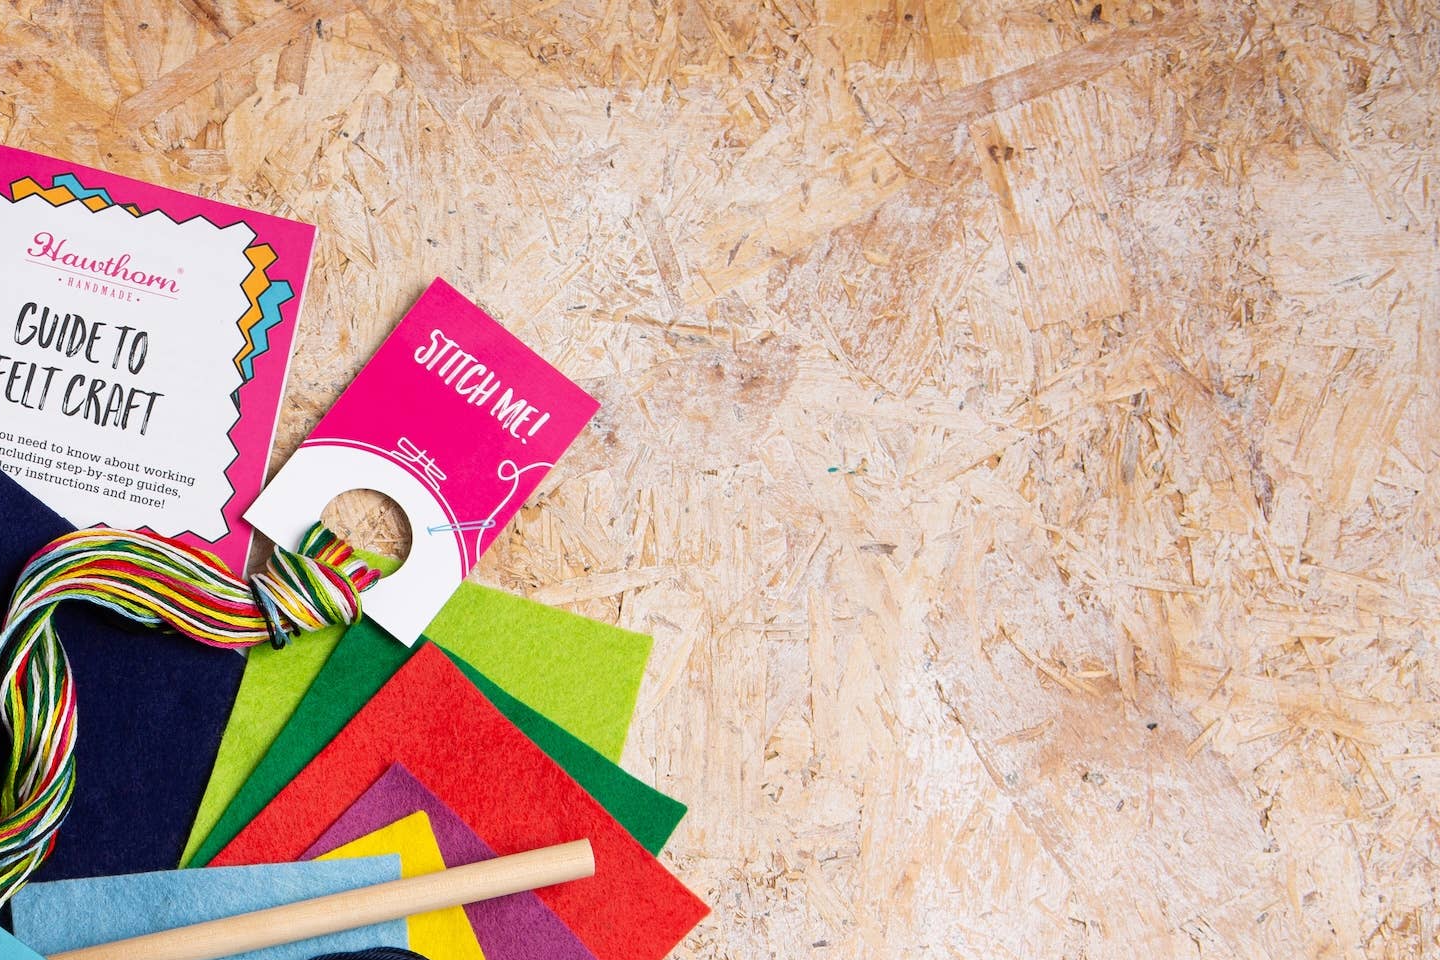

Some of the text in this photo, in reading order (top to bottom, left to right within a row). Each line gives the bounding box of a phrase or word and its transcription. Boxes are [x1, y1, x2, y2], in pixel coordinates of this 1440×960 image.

[27, 232, 180, 293] Hawthorn
[68, 277, 132, 302] HANDMADE
[14, 302, 148, 375] GUIDE TO
[62, 374, 165, 436] CRAFT
[414, 329, 551, 444] STITCH ME!
[17, 434, 48, 451] need
[51, 443, 63, 454] to
[67, 446, 101, 463] know
[104, 455, 140, 473] about
[144, 466, 195, 486] working
[25, 467, 99, 494] instructions
[103, 486, 126, 501] and
[129, 492, 165, 509] more!
[56, 460, 133, 488] step-by-step
[137, 476, 181, 498] guides,
